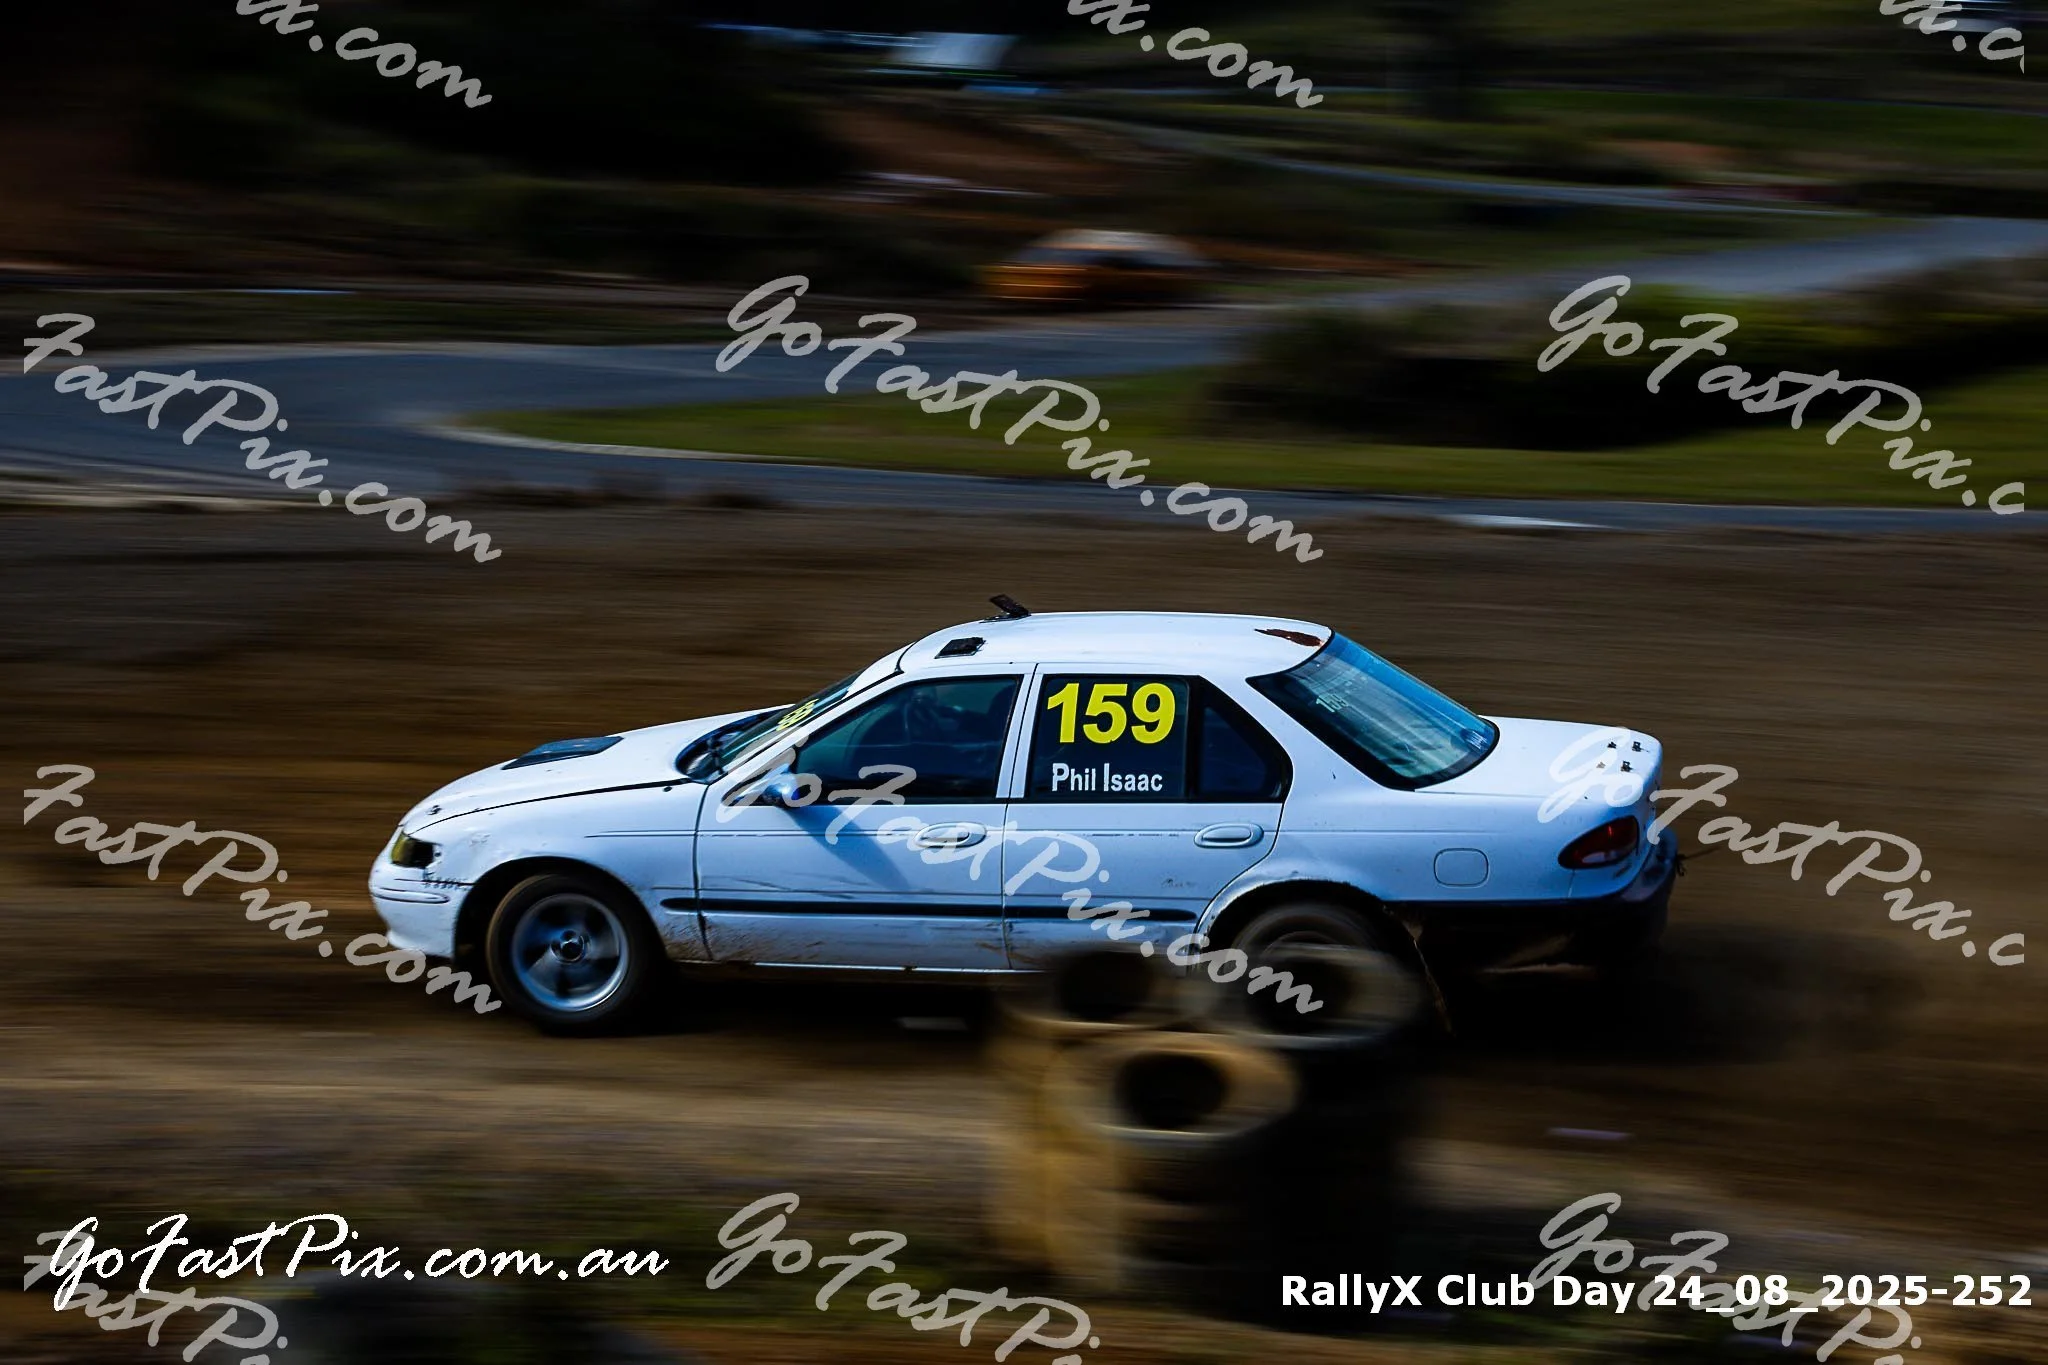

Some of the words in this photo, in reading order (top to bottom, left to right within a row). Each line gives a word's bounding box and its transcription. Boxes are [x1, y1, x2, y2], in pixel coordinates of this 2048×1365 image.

[1048, 683, 1176, 744] 159
[1052, 763, 1096, 791] Phil
[1104, 763, 1163, 791] Isaac
